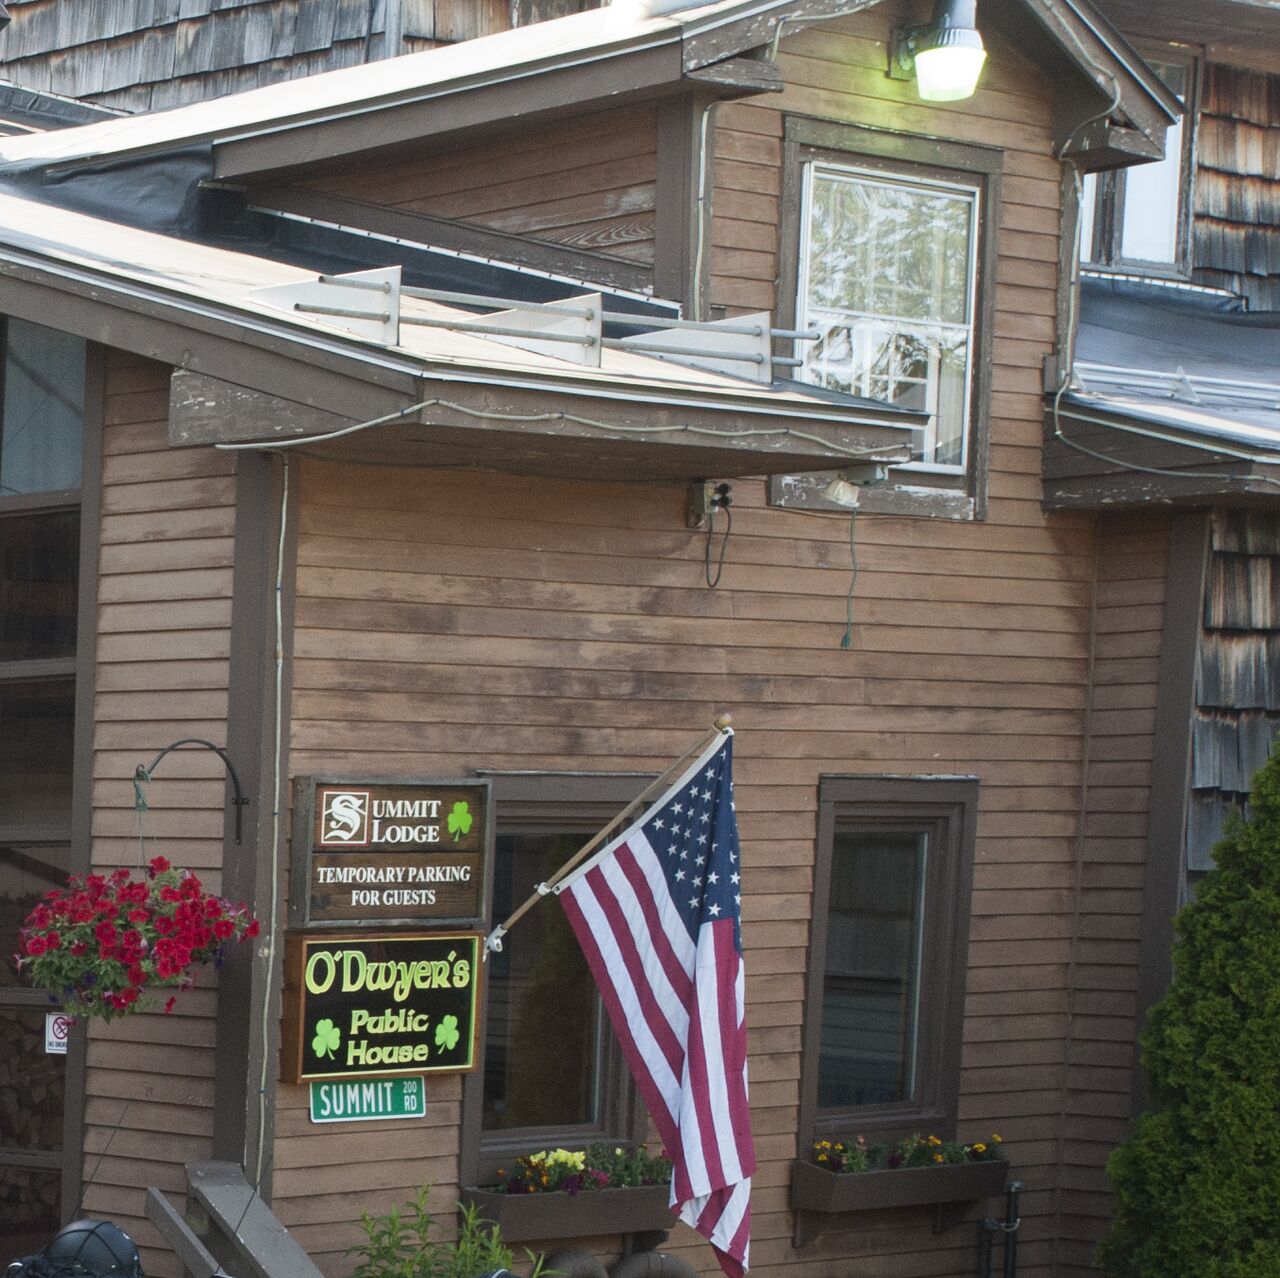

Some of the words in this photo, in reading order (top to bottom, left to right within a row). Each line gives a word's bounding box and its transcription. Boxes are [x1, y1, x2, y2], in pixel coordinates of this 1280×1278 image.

[372, 820, 440, 843] LODGE
[318, 867, 406, 883] TEMPORARY
[408, 866, 471, 882] PARKING
[351, 890, 380, 906] FOR
[383, 890, 436, 905] GUESTS
[350, 1008, 429, 1035] Public
[346, 1040, 429, 1066] House
[320, 1082, 393, 1116] SUMMIT
[403, 1081, 417, 1093] 200
[404, 1095, 417, 1111] RD
